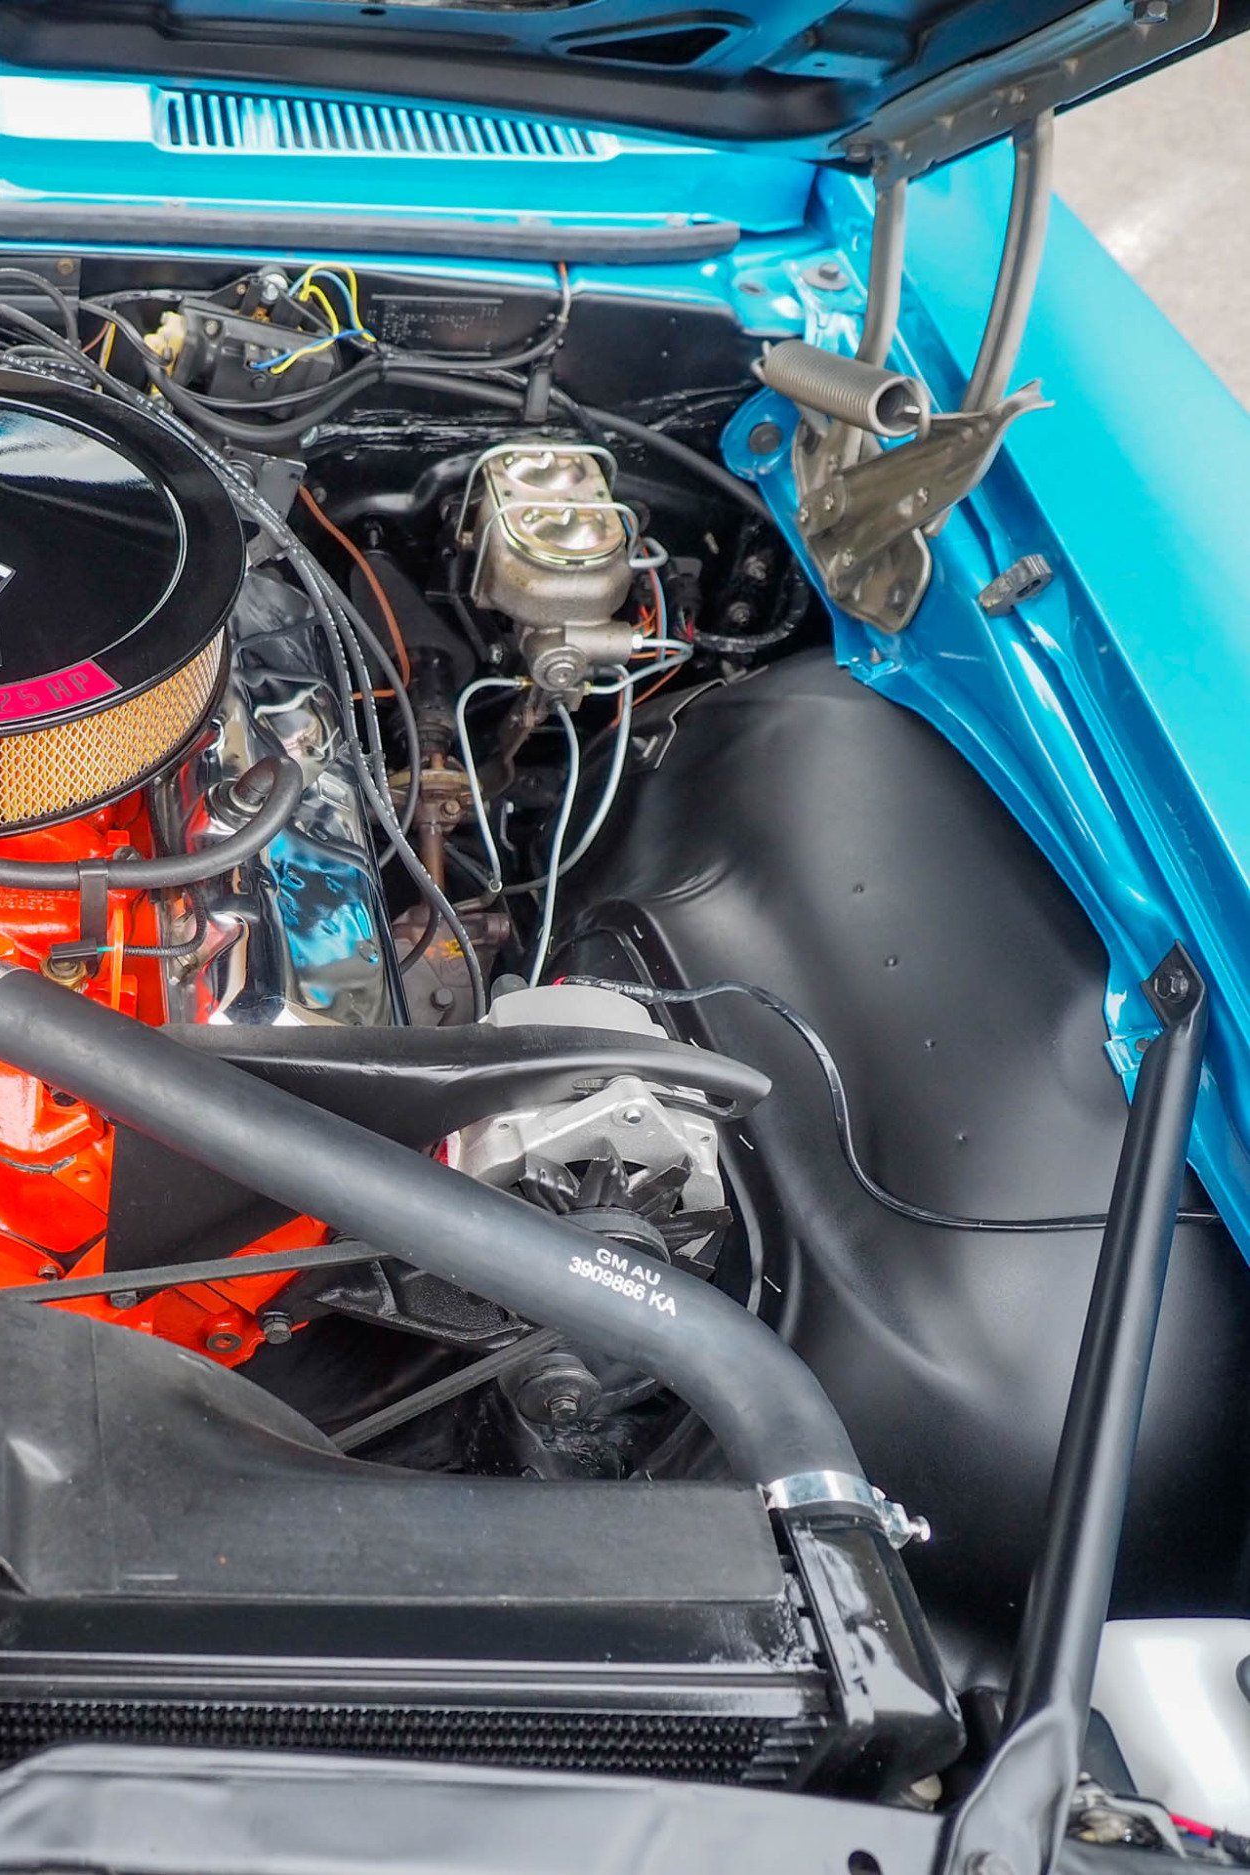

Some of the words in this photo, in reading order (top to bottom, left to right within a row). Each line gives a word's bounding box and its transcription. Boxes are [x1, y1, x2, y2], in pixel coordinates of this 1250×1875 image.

[46, 671, 89, 702] HP
[596, 1248, 629, 1272] GM
[630, 1265, 661, 1286] AU
[568, 1256, 646, 1301] 3909866
[648, 1289, 677, 1317] KA
